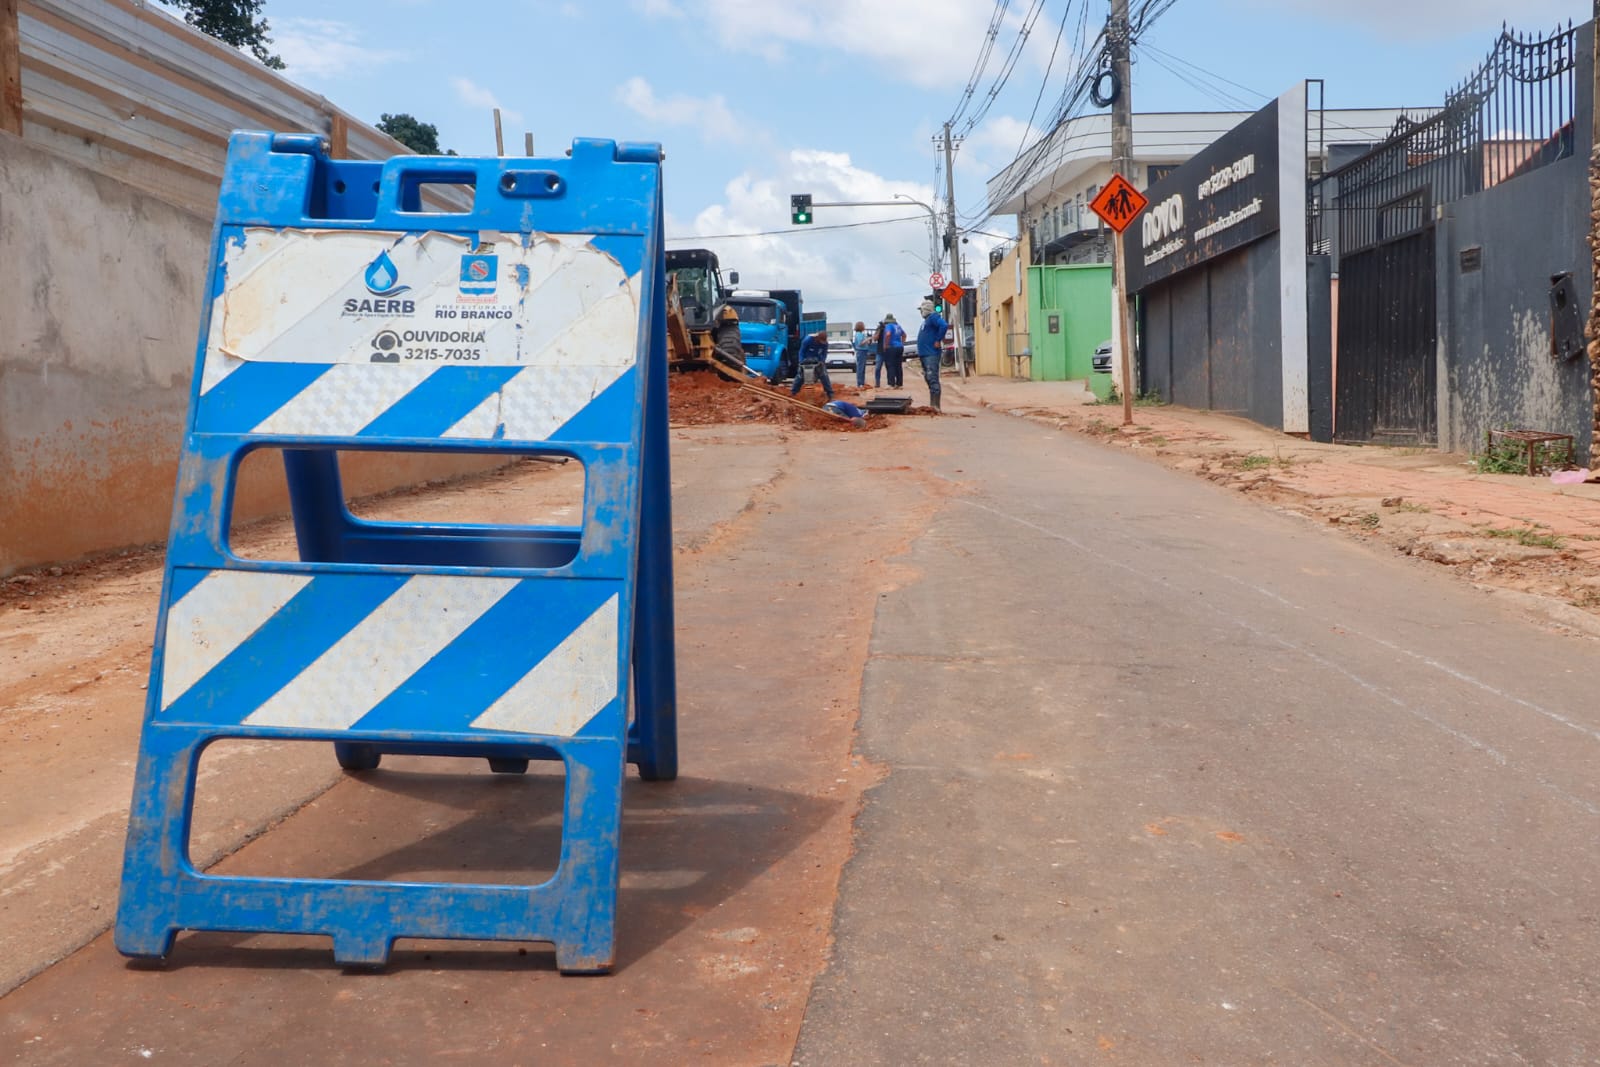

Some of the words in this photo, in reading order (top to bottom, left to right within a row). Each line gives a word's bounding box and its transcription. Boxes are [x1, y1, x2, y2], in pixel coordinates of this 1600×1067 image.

[1142, 194, 1183, 248] nova
[344, 299, 415, 313] SAERB
[435, 310, 457, 319] RIO
[461, 310, 513, 320] BRANCO
[403, 330, 485, 343] OUVIDORIA
[404, 348, 481, 360] 3215-7035
